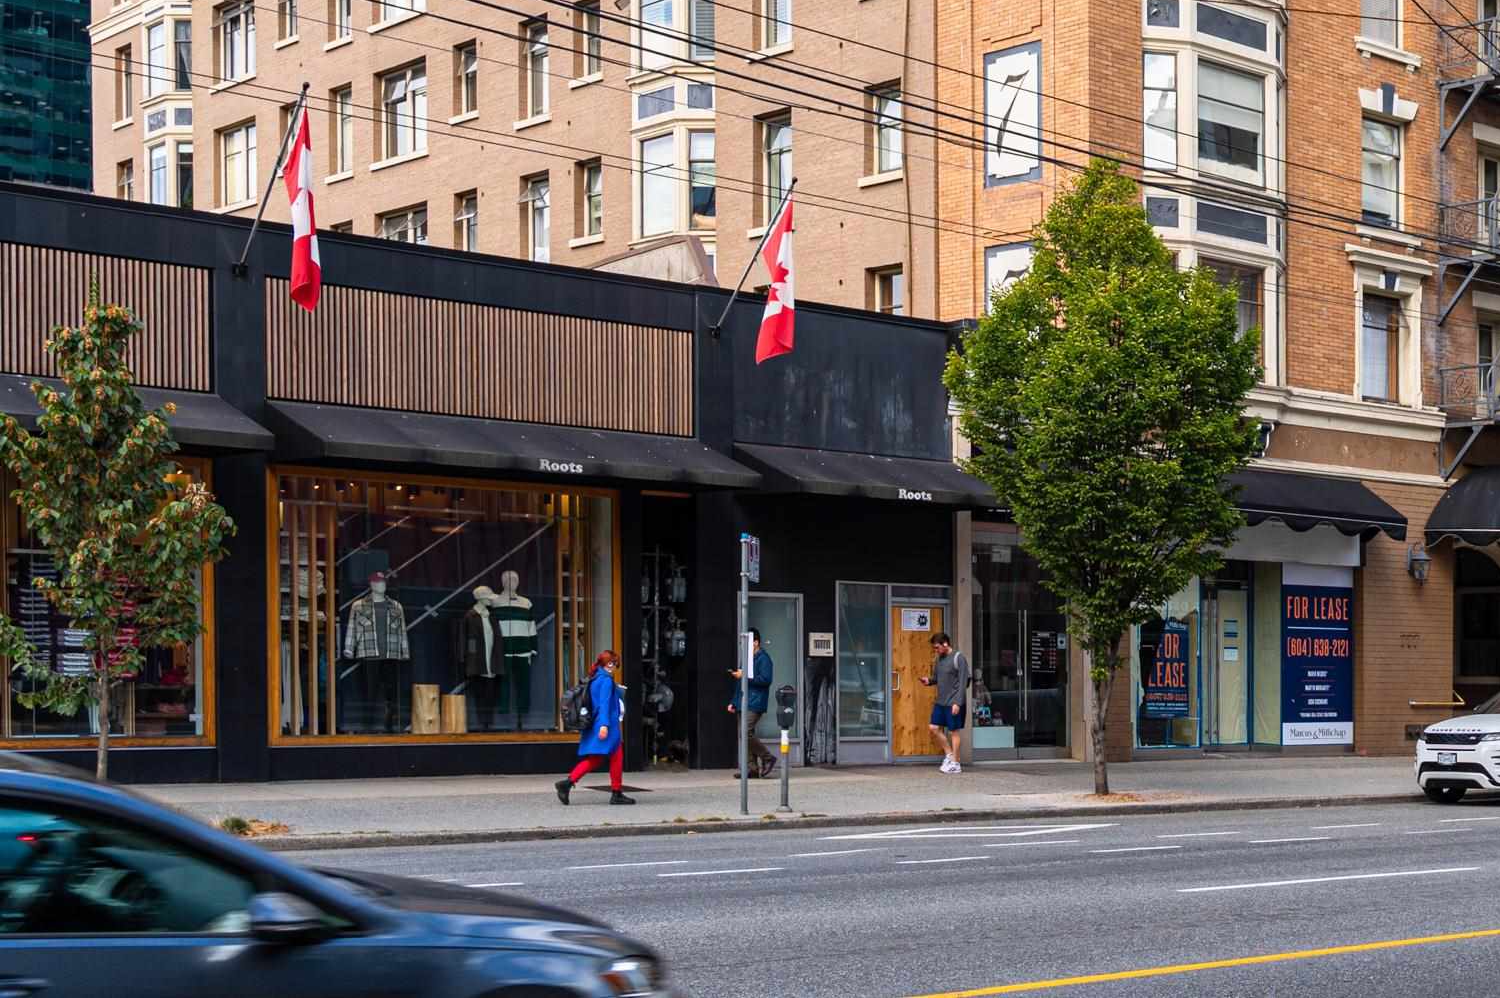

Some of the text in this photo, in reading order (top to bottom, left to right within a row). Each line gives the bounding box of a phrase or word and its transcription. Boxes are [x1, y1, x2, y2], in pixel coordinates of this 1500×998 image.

[995, 69, 1029, 158] 7
[539, 458, 583, 474] Roots
[898, 488, 932, 501] Roots
[1287, 596, 1349, 620] FOR LEASE
[1148, 663, 1186, 687] LEASE
